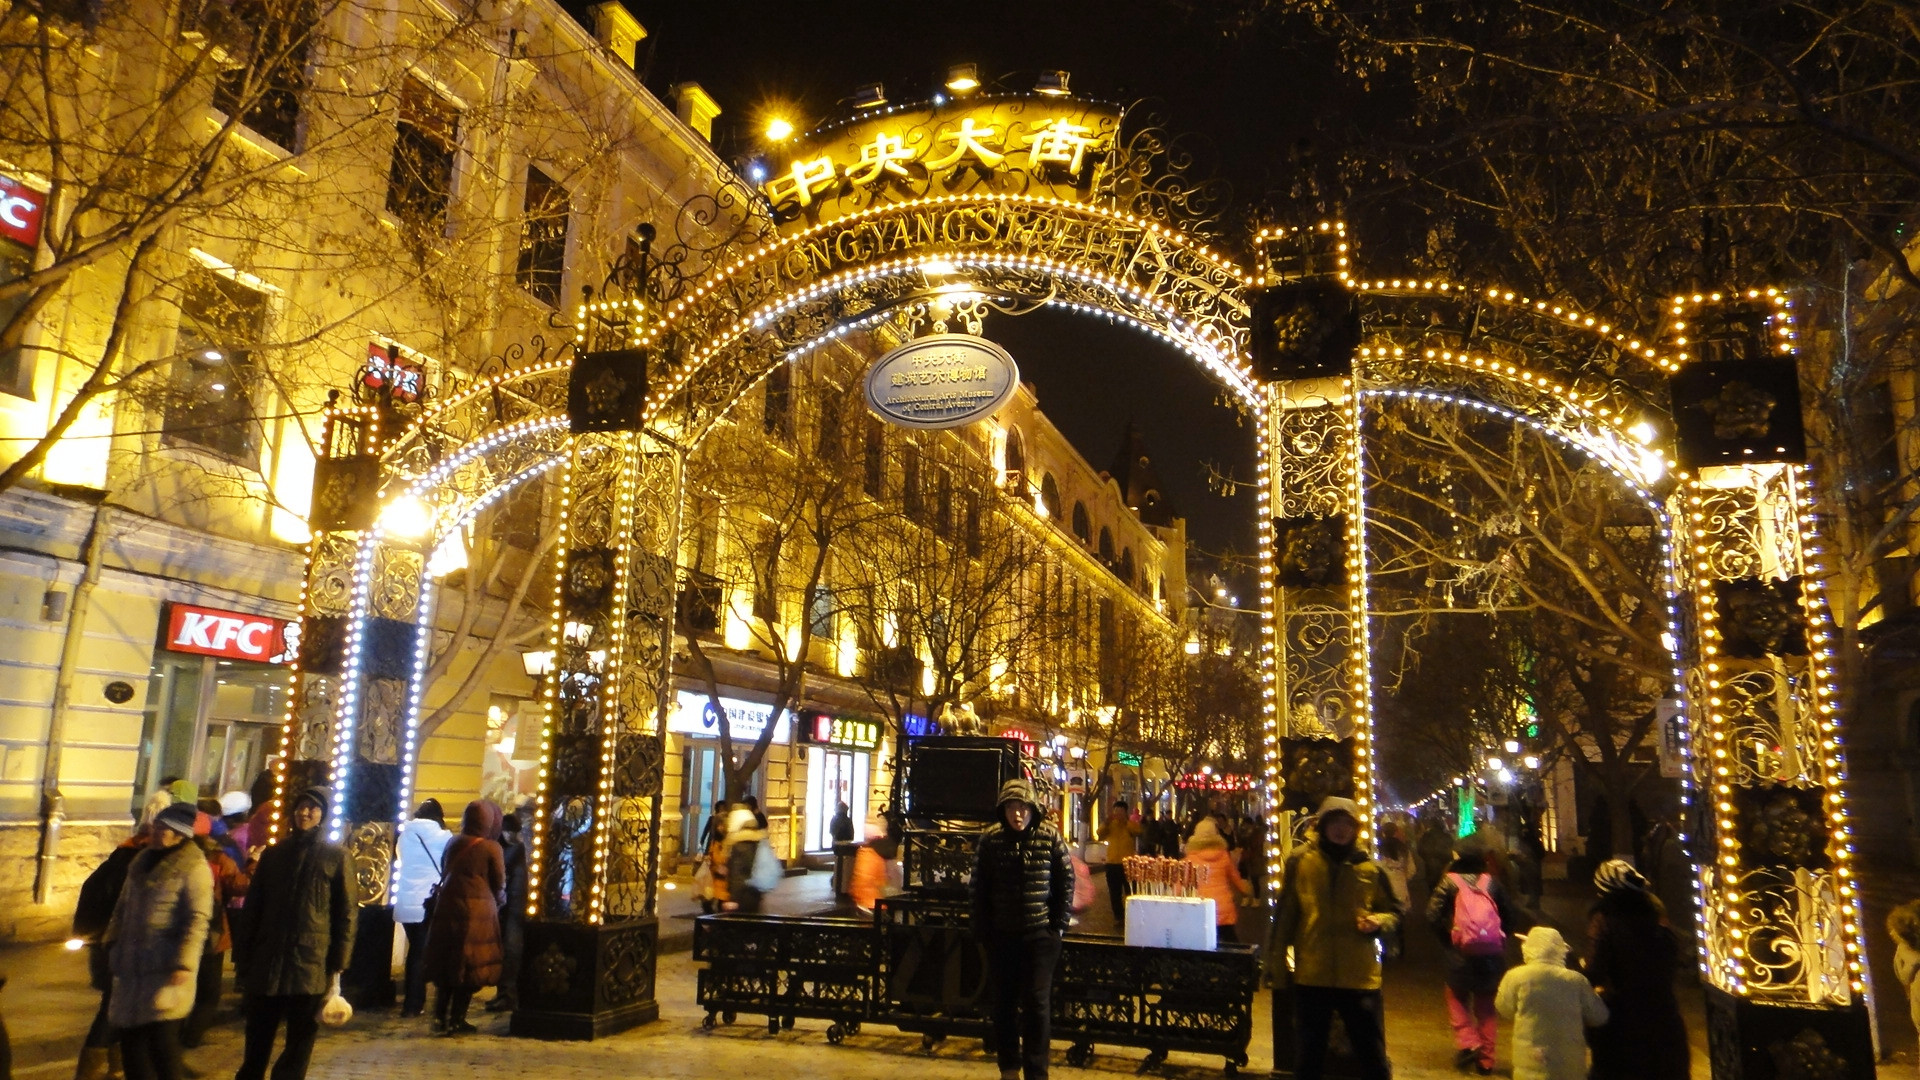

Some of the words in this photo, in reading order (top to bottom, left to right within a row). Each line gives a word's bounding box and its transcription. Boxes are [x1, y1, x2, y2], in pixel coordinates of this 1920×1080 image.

[765, 117, 1104, 207] 中央大街
[912, 351, 966, 368] 中央大街
[891, 365, 988, 387] 建筑艺术博物馆
[885, 393, 937, 404] Architectural
[940, 392, 957, 400] Arts
[960, 390, 994, 398] Museum
[902, 403, 911, 412] of
[914, 402, 943, 411] Central
[945, 400, 976, 409] Avenue
[174, 612, 268, 655] KFC
